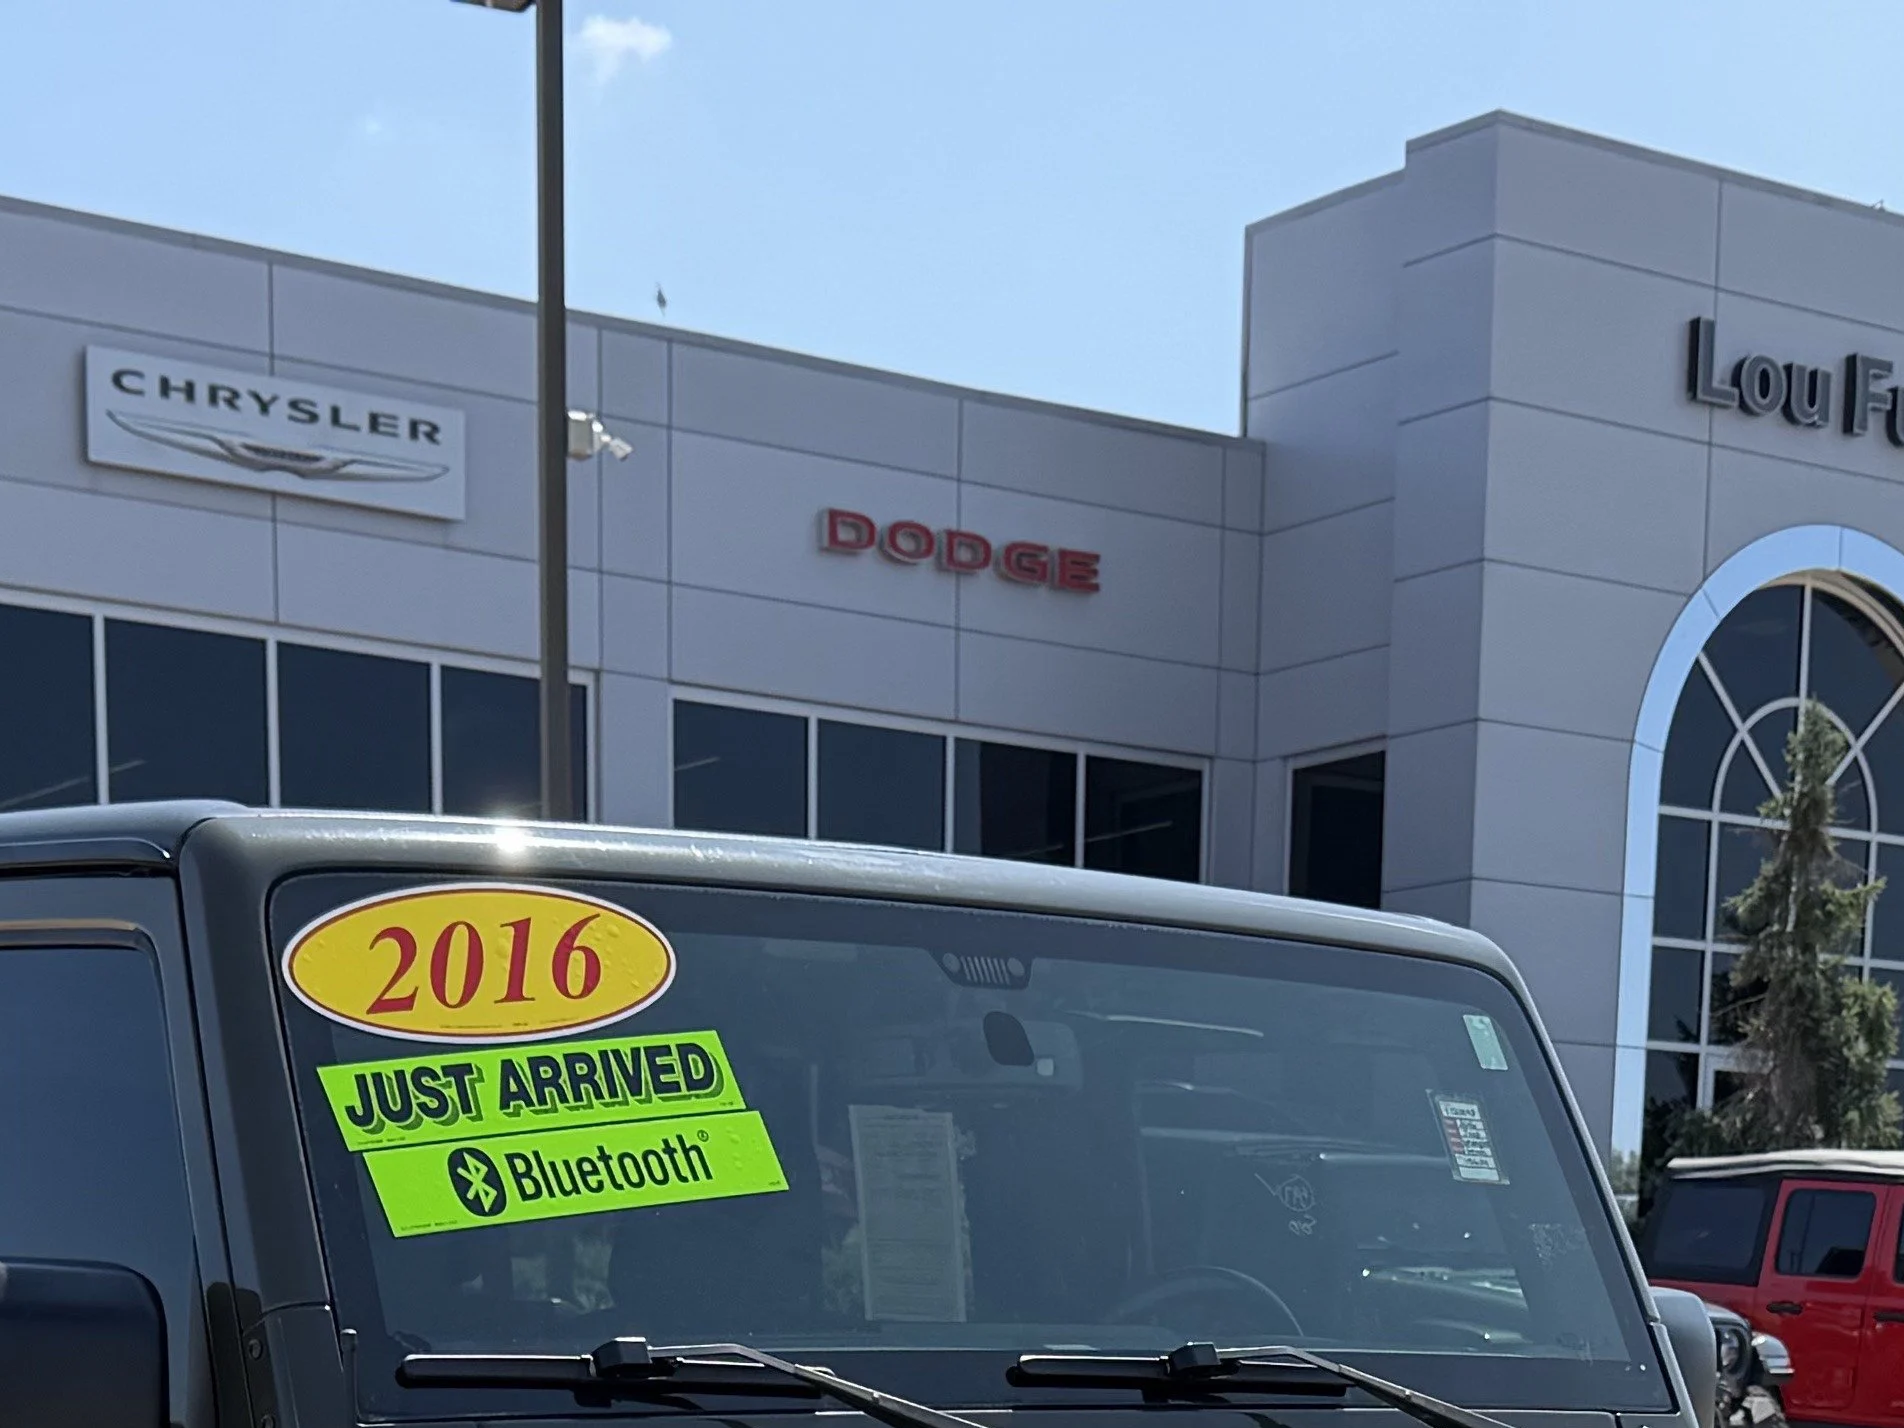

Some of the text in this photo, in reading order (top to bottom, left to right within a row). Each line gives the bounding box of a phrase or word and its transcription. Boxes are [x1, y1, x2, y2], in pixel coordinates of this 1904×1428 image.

[110, 368, 442, 446] CHRYSLER
[1687, 316, 1832, 428] Lou
[818, 508, 1101, 593] DODGE
[365, 912, 602, 1015] 2016
[344, 1041, 725, 1134] JUST ARRIVED
